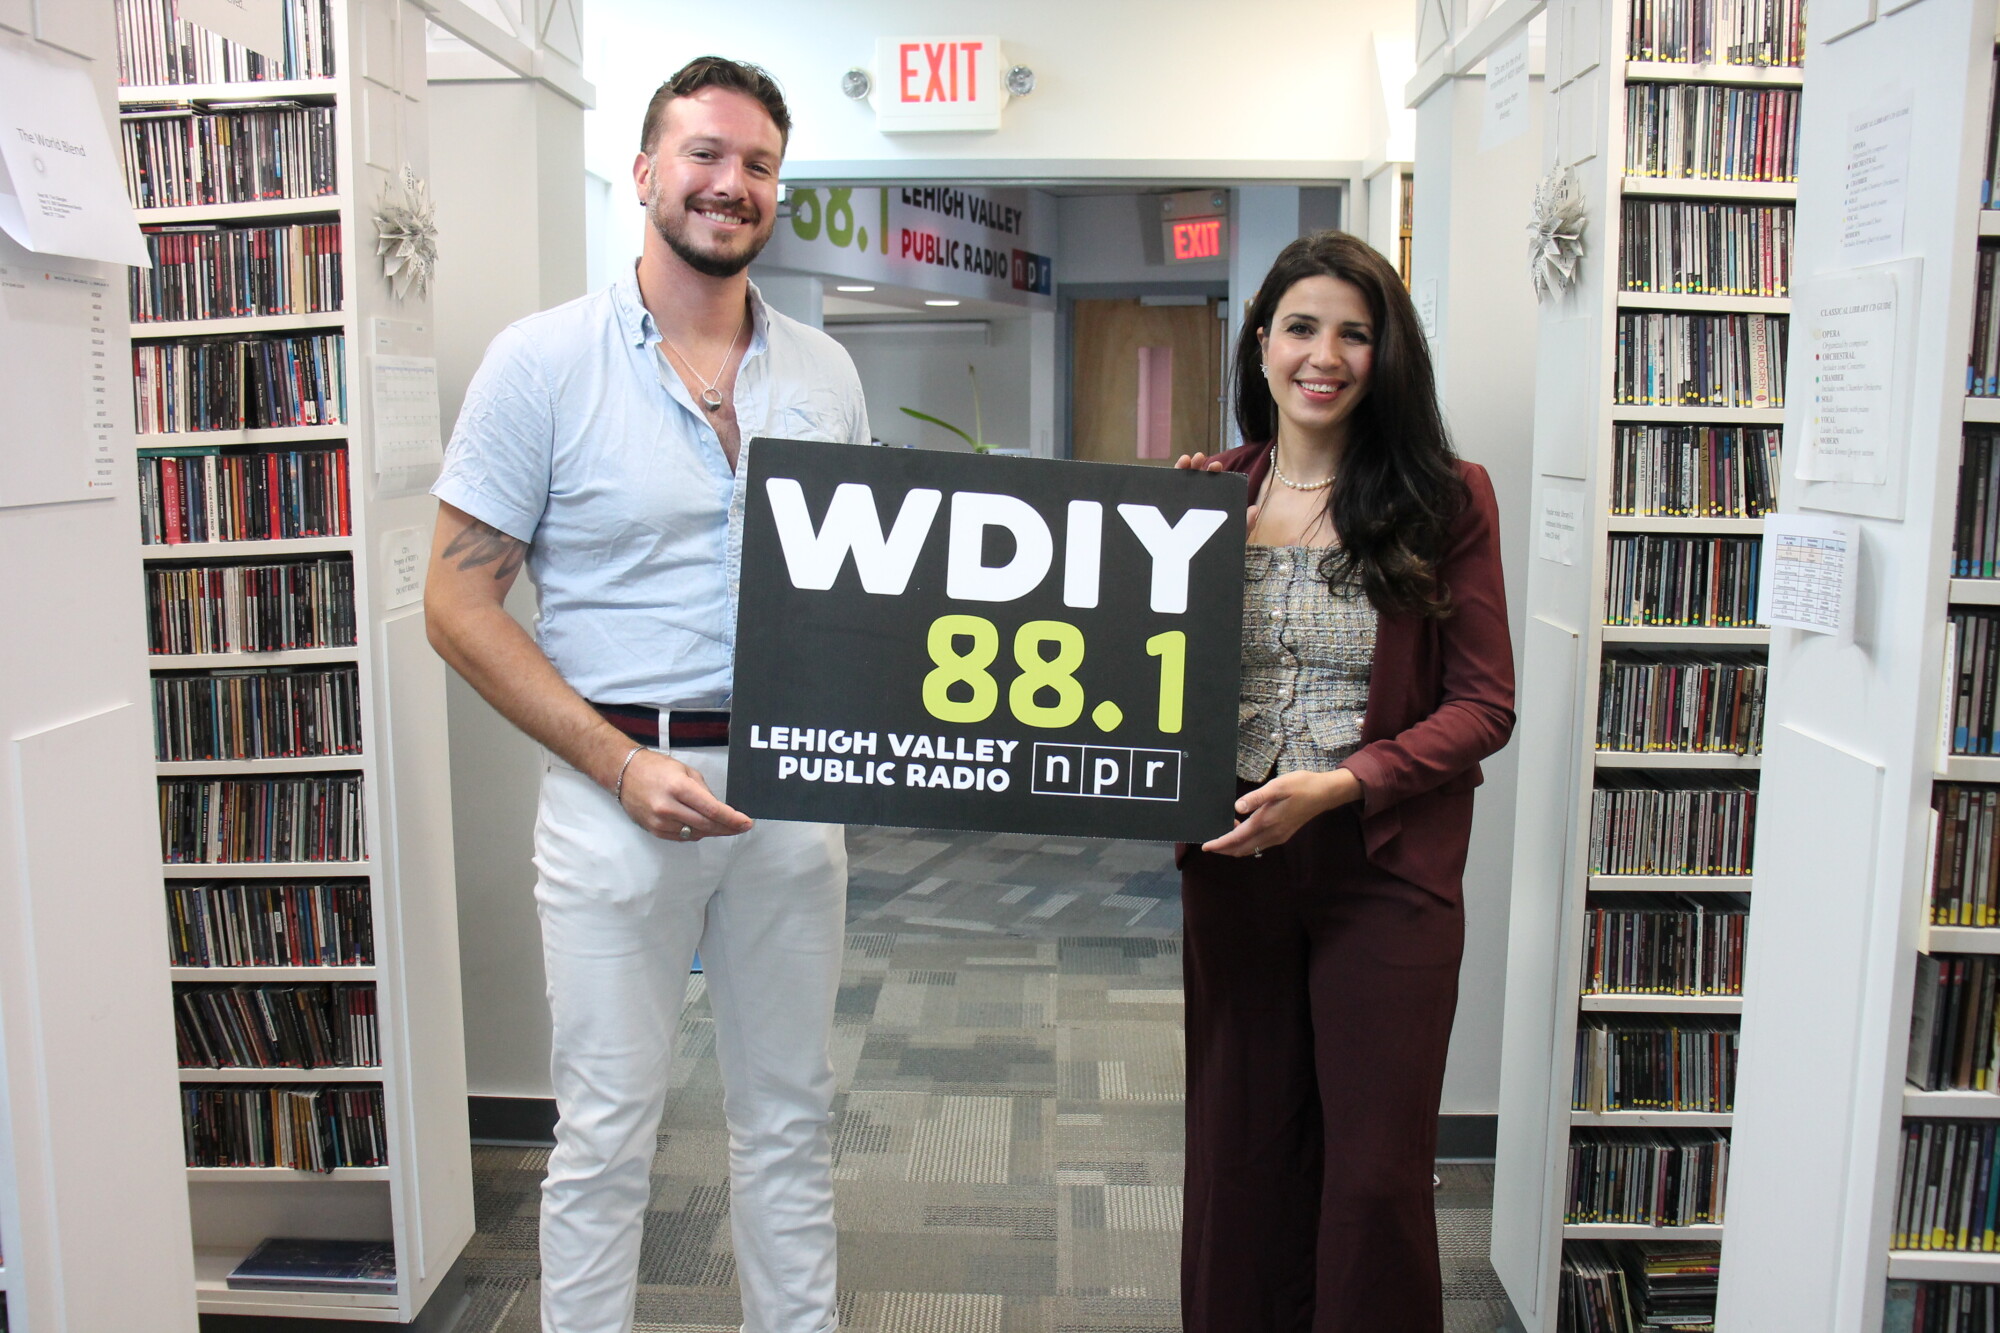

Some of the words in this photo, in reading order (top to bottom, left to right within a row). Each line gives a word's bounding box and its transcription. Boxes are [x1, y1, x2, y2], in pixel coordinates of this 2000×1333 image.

[901, 42, 983, 103] EXIT
[16, 127, 35, 144] The
[35, 132, 62, 151] World
[61, 140, 86, 157] Blend
[790, 188, 888, 255] 88.1
[901, 188, 964, 220] LEHIGH
[968, 195, 1022, 236] VALLEY
[902, 228, 960, 270] PUBLIC
[964, 243, 1008, 280] RADIO
[1014, 258, 1048, 289] npr
[1174, 220, 1221, 260] EXIT
[1756, 320, 1764, 342] TODD
[1820, 306, 1848, 317] CLASSICAL
[1822, 330, 1840, 338] OPERA
[1757, 344, 1767, 390] RUNDGREN
[1822, 352, 1855, 361] ORCHESTRAL
[1822, 374, 1844, 382] CHAMBER
[766, 477, 1228, 614] WDIY
[922, 614, 1186, 734] 88.1
[750, 725, 878, 756] LEHIGH
[888, 732, 1019, 764] VALLEY
[778, 756, 896, 786] PUBLIC
[906, 763, 1010, 792] RADIO
[1046, 754, 1165, 794] npr
